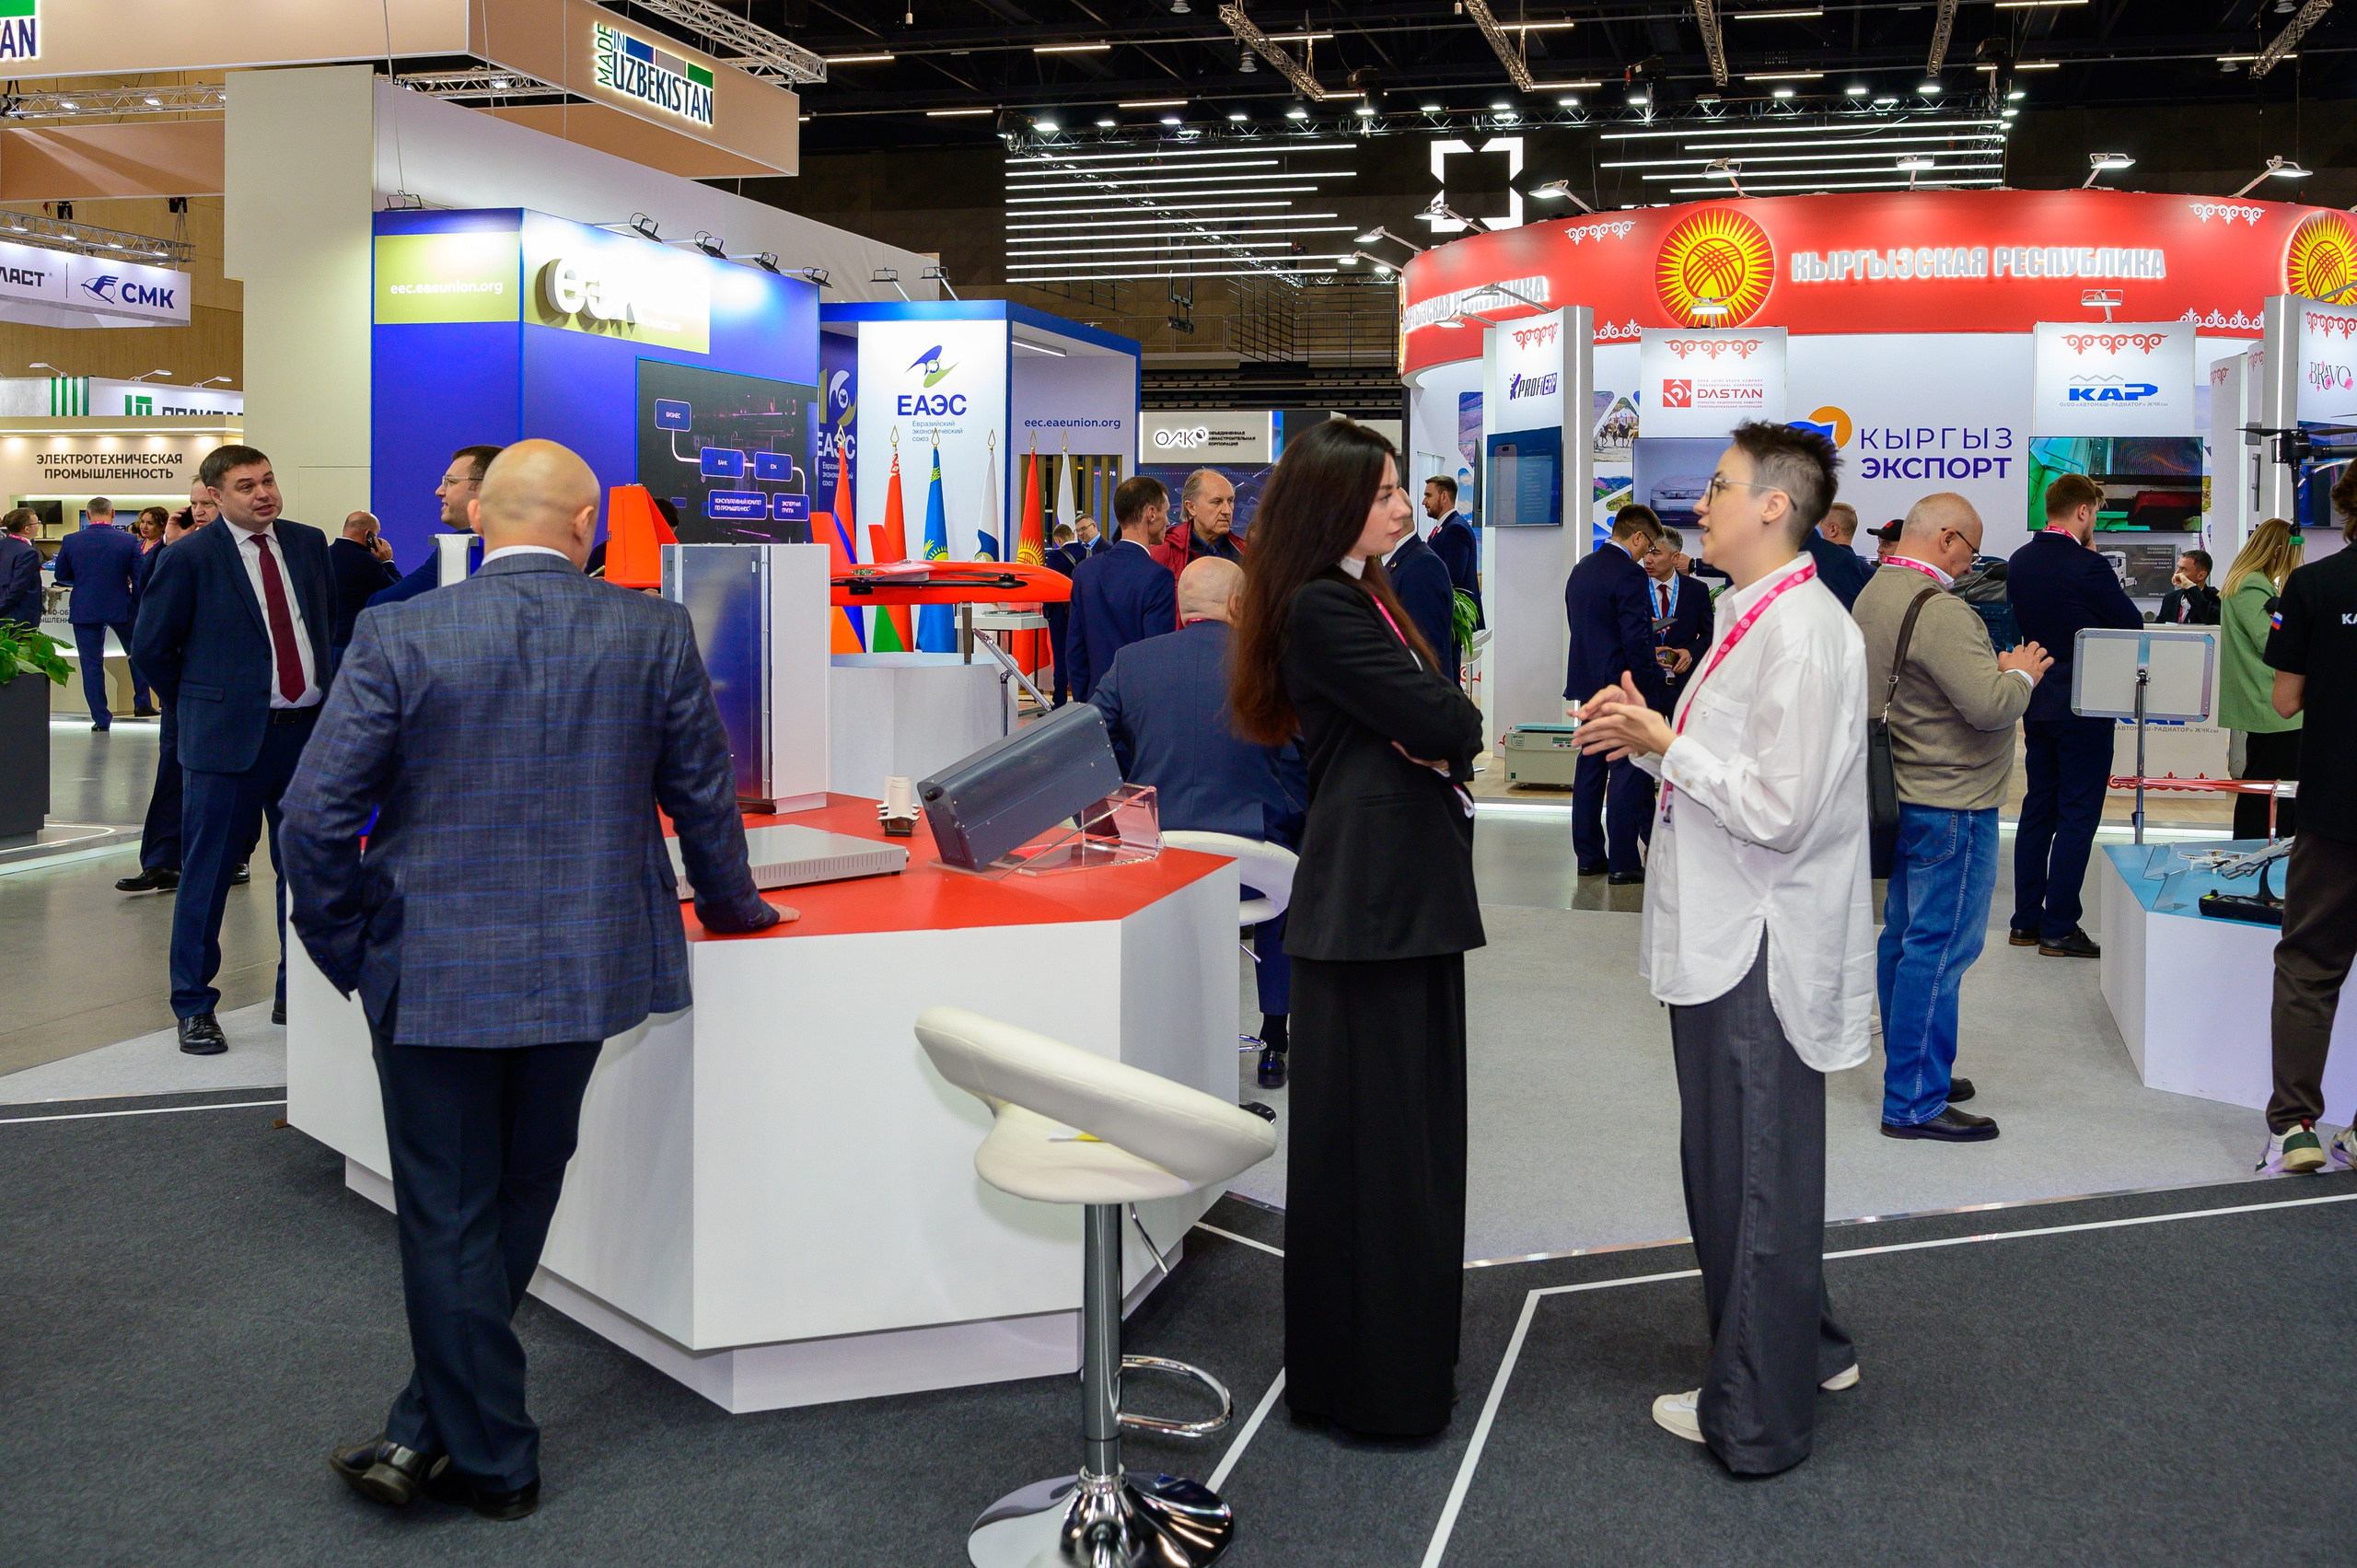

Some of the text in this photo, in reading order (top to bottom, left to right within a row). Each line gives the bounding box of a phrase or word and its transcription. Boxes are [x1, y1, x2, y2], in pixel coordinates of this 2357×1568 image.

[613, 30, 625, 52] IN
[597, 23, 614, 87] MADE
[613, 52, 714, 124] UZBEKISTAN
[1791, 248, 2166, 281] КЫРГЫЗСКАЯ РЕСПУБЛИКА
[122, 283, 175, 309] СМК
[390, 280, 504, 296] eec.eaeunion.org
[898, 394, 967, 416] ЕАЭС
[1697, 389, 1763, 399] DASTAN
[911, 420, 956, 428] Евразийский
[1024, 417, 1121, 430] eec.eaeunion.org
[1861, 427, 2013, 449] КЫРГЫЗ
[36, 453, 183, 465] ЭЛЕКТРОТЕХНИЧЕСКАЯ
[1861, 457, 2013, 479] ЭКСПОРТ
[44, 468, 174, 479] ПРОМЫШЛЕННОСТЬ
